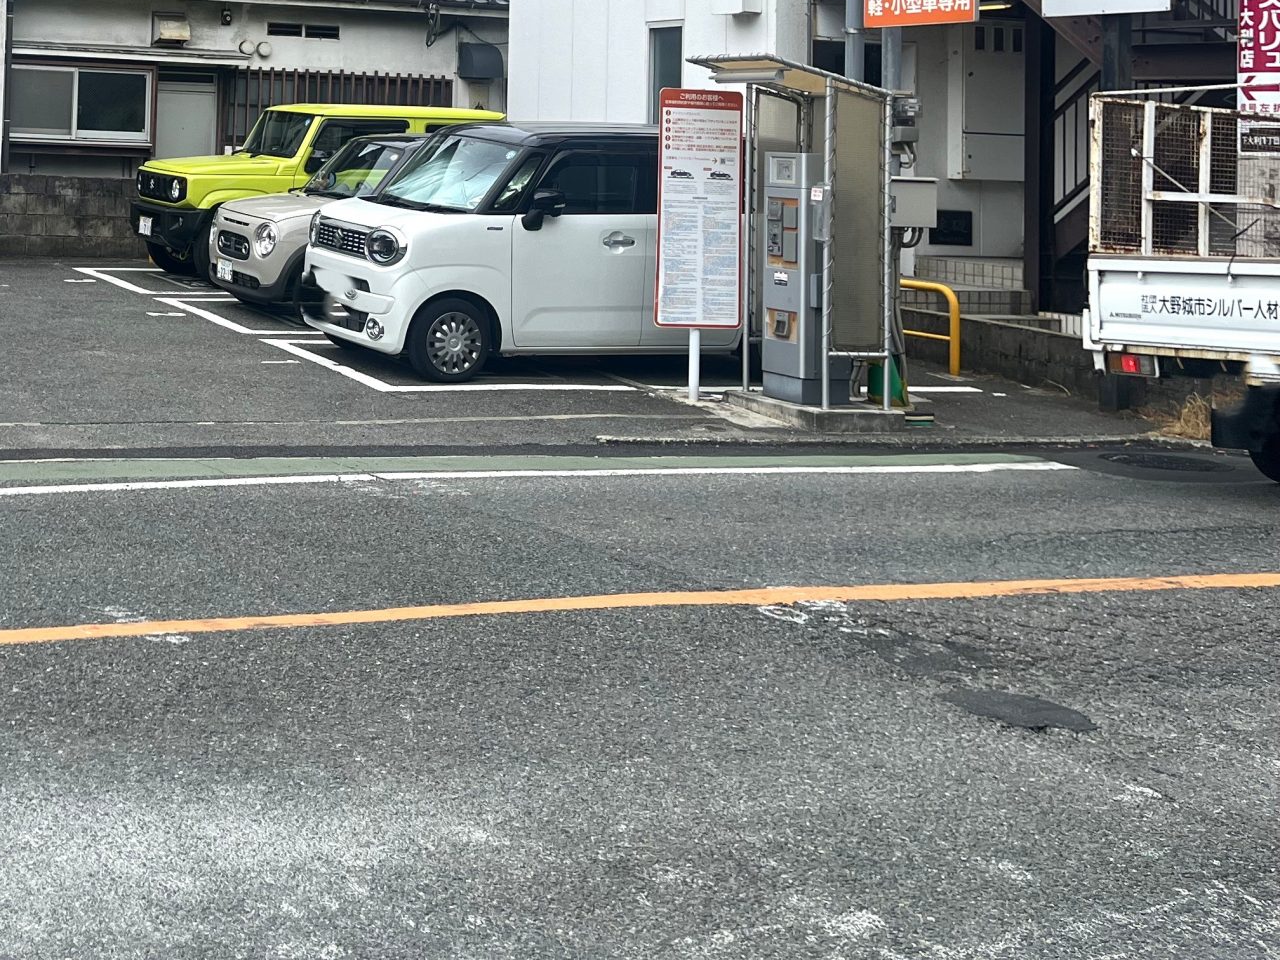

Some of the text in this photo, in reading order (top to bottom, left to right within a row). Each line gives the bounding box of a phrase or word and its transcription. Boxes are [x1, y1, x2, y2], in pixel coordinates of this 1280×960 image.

[1158, 295, 1280, 320] 大野城市シルバー人材
